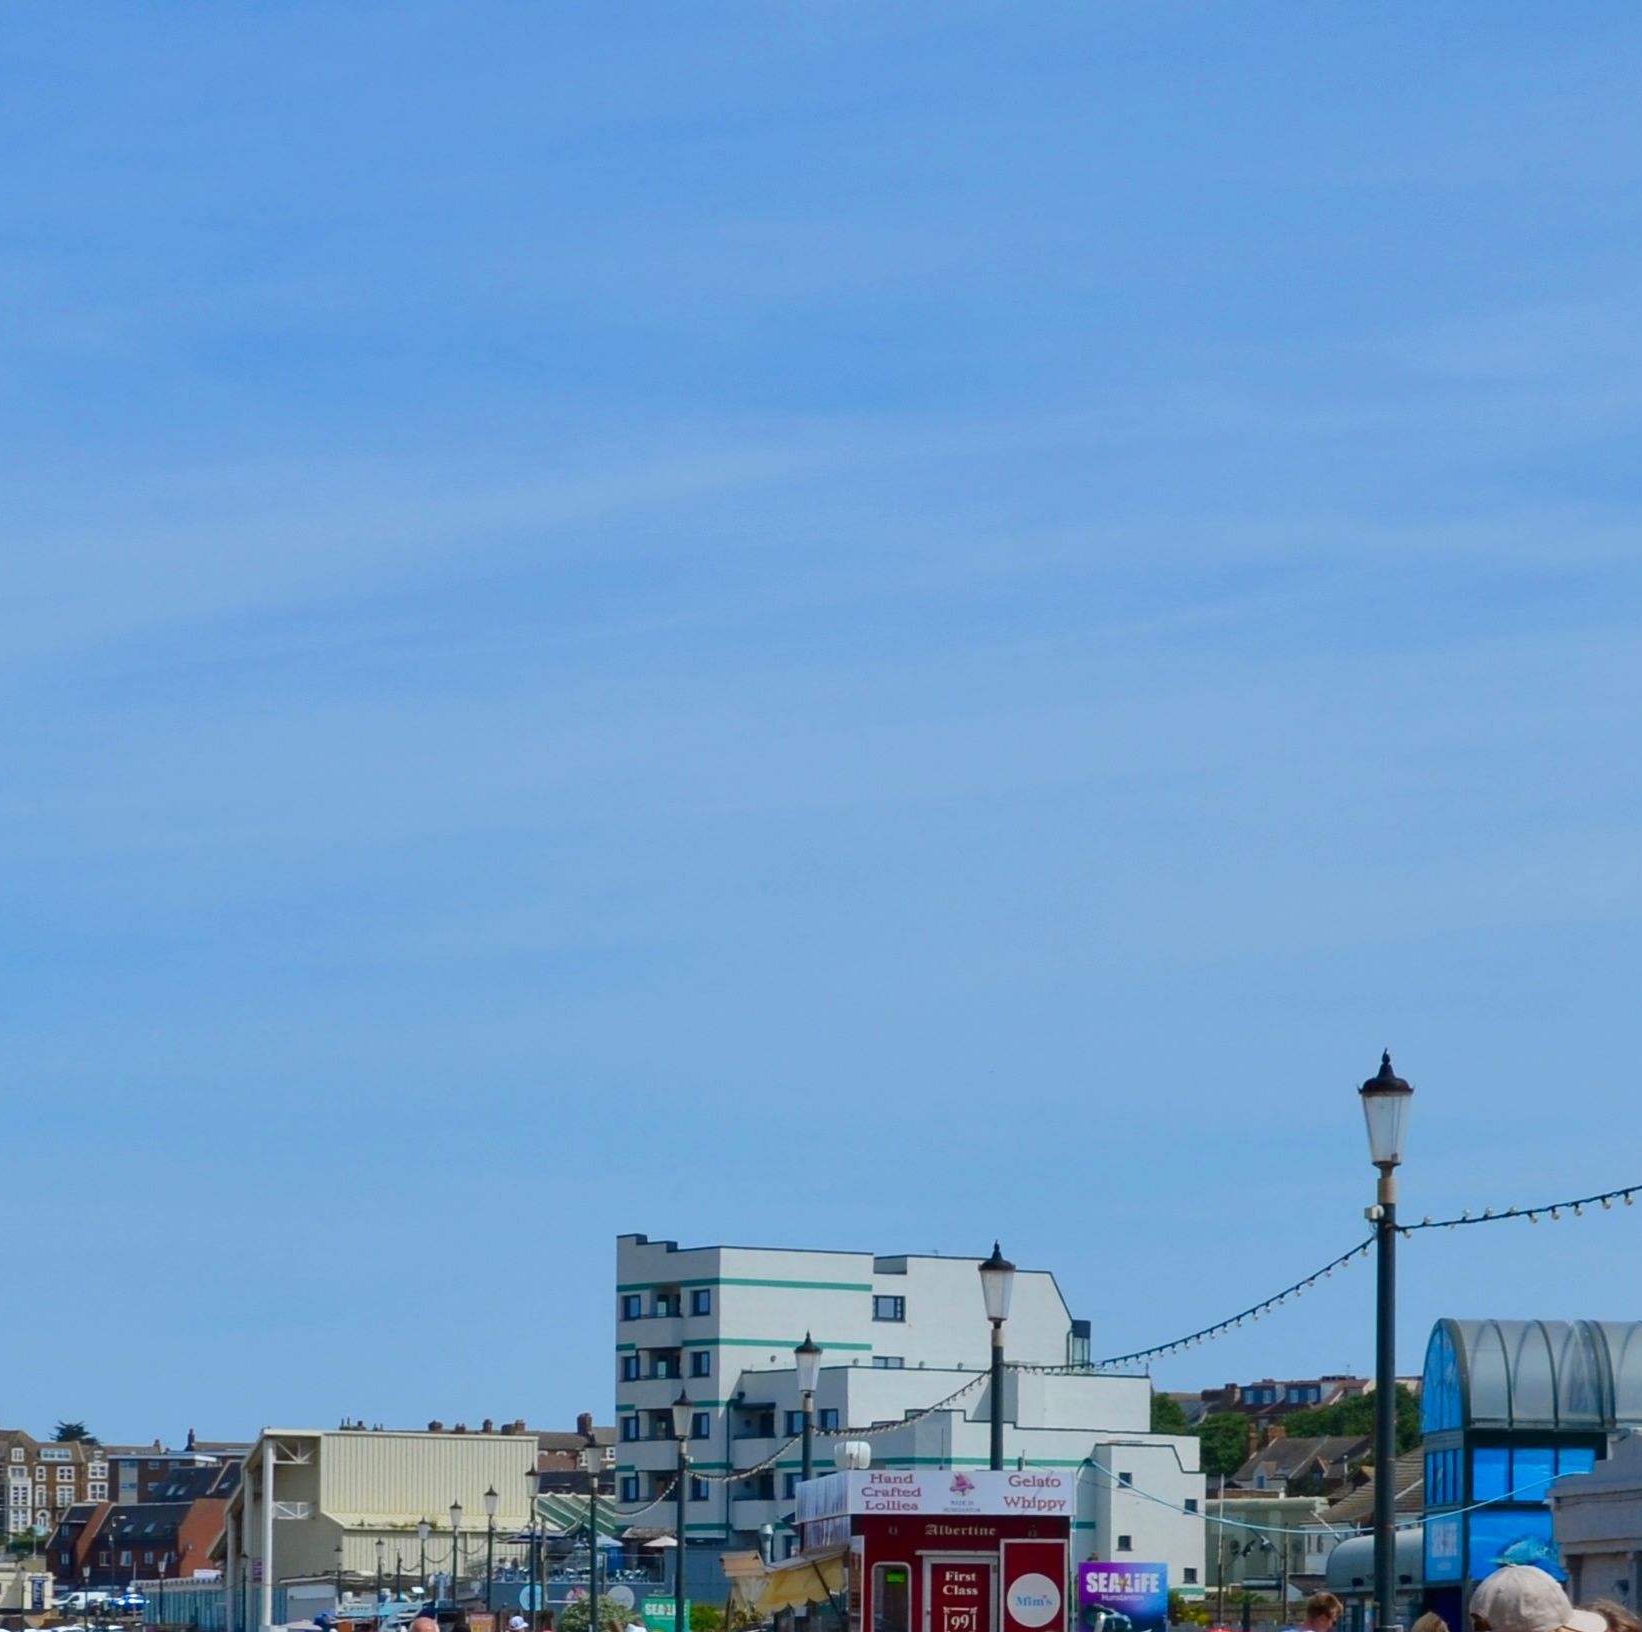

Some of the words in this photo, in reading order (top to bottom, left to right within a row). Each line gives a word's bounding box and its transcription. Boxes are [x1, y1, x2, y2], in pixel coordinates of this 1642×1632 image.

[870, 1473, 913, 1484] Hand
[1008, 1475, 1061, 1487] Gelato
[861, 1486, 921, 1498] Crafted
[864, 1500, 919, 1511] Lollies
[1004, 1496, 1067, 1511] Whippy
[925, 1524, 997, 1536] Albertine
[945, 1571, 976, 1581] First
[1086, 1572, 1120, 1593] SEA
[942, 1584, 979, 1595] Class
[950, 1614, 970, 1630] 99
